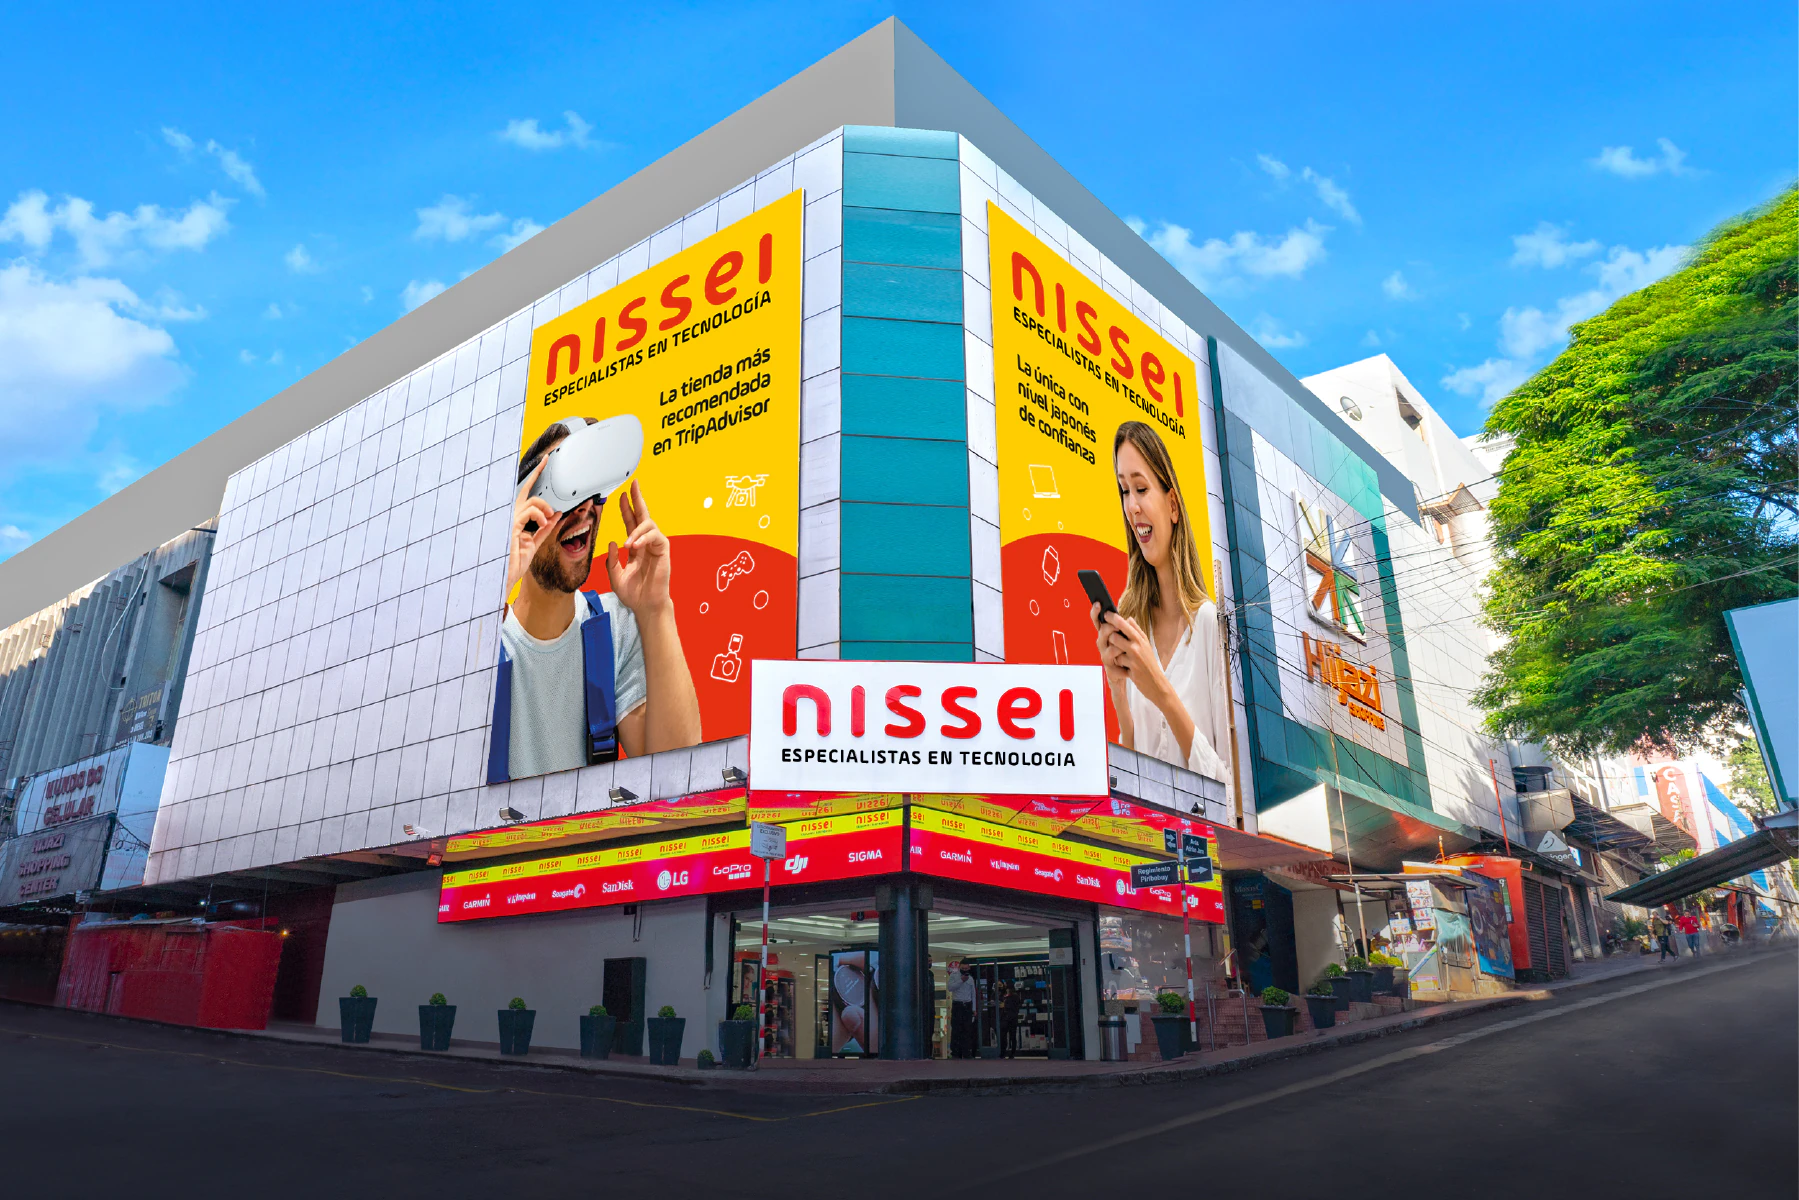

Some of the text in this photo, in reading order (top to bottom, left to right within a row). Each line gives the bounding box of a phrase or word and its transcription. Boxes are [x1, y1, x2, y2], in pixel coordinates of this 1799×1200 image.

[544, 290, 771, 406] ESPECIALISTAS EN TECNOLOGÍA
[1013, 306, 1186, 439] ESPECIALISTAS EN TECNOLOGÍA
[660, 348, 771, 406] La tienda más
[661, 373, 771, 429] recomendada
[1017, 354, 1089, 416] La única con
[653, 398, 770, 456] en TripAdvisor
[1018, 382, 1097, 443] nivel japonés
[1019, 405, 1096, 465] de confianza
[781, 748, 1076, 767] ESPECIALISTAS EN TECNOLOGIA
[672, 871, 689, 886] LG
[848, 849, 883, 863] SIGMA
[940, 850, 972, 864] GARMIN
[1137, 866, 1171, 876] Regimiento
[463, 899, 491, 909] GARMIN
[602, 879, 634, 893] SanDisk
